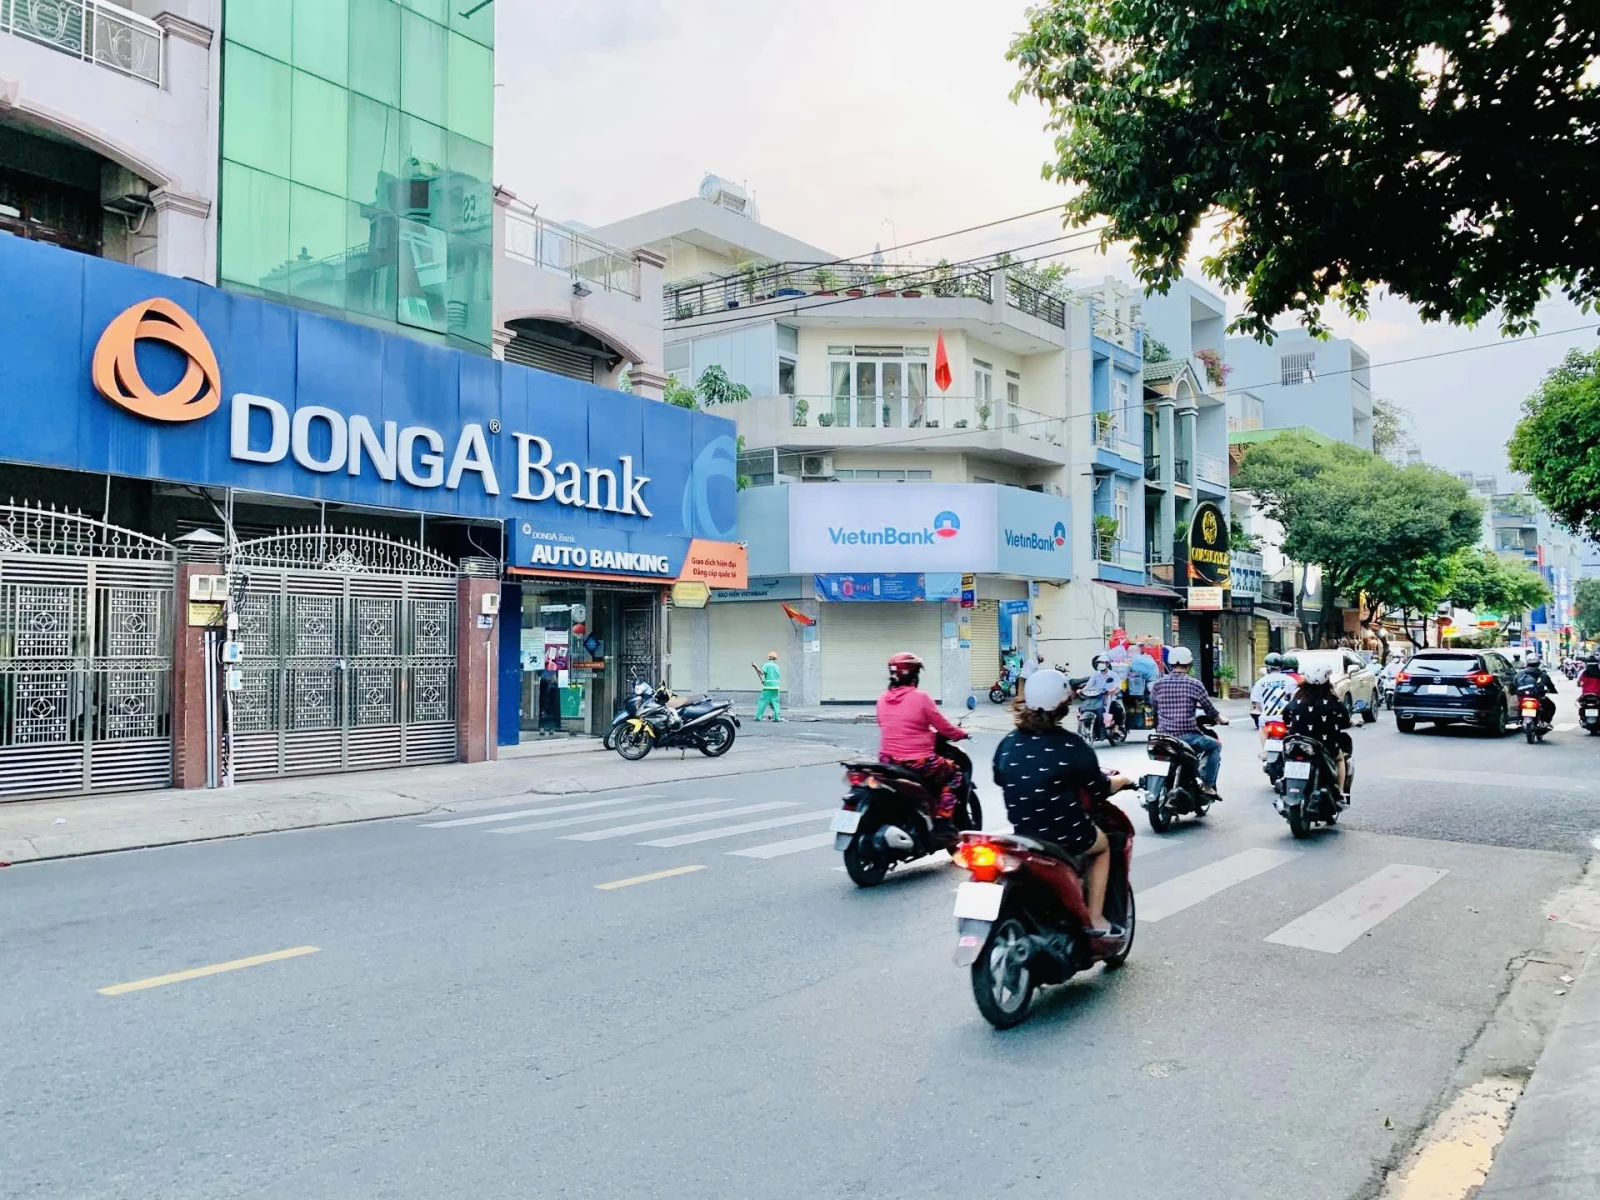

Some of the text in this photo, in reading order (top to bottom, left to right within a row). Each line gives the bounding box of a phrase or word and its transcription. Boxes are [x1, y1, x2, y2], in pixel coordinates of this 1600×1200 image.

[511, 432, 653, 517] Bank
[532, 530, 577, 543] DONGA Bank
[827, 527, 936, 545] VietinBank
[1004, 528, 1055, 552] VietinBank
[530, 543, 670, 574] AUTO BANKING
[691, 557, 704, 565] Giao
